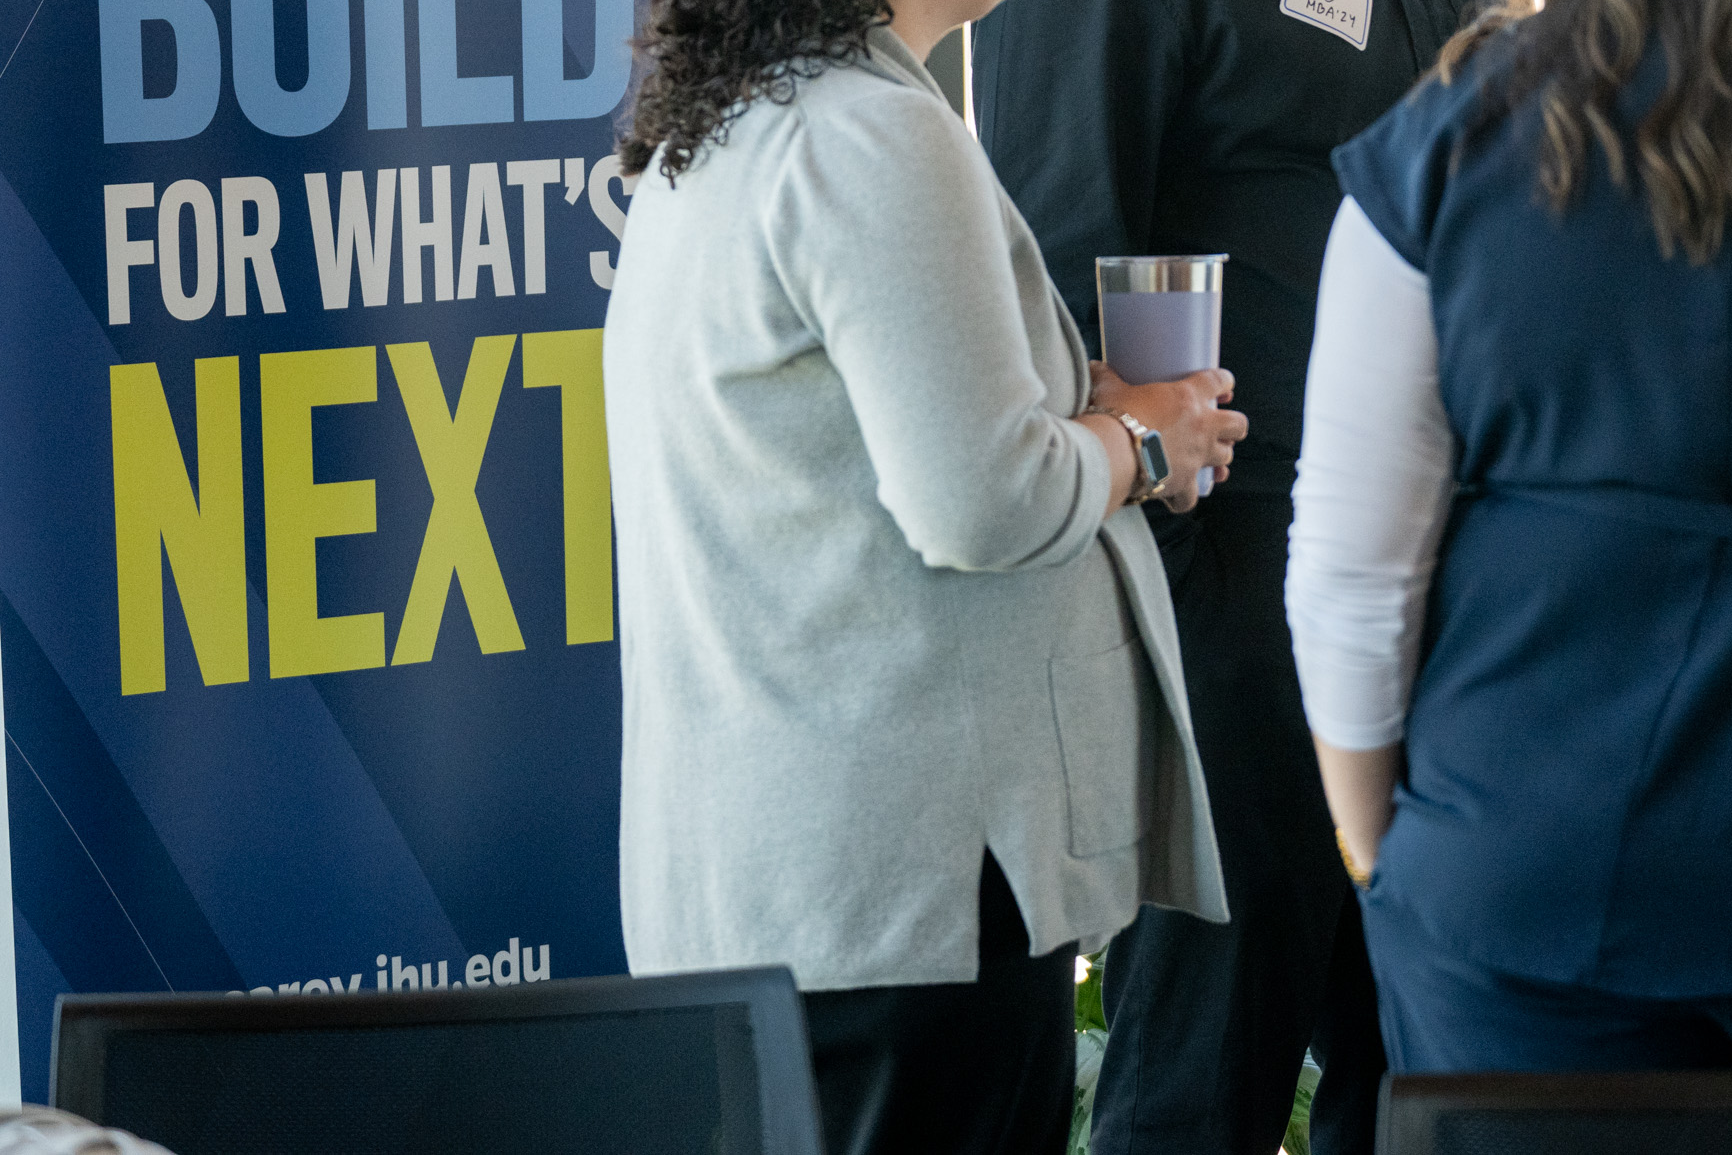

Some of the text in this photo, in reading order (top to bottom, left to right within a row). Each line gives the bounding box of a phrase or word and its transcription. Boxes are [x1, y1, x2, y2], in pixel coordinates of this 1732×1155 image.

[104, 155, 642, 325] FOR WHAT'S
[109, 327, 614, 696] NEXT
